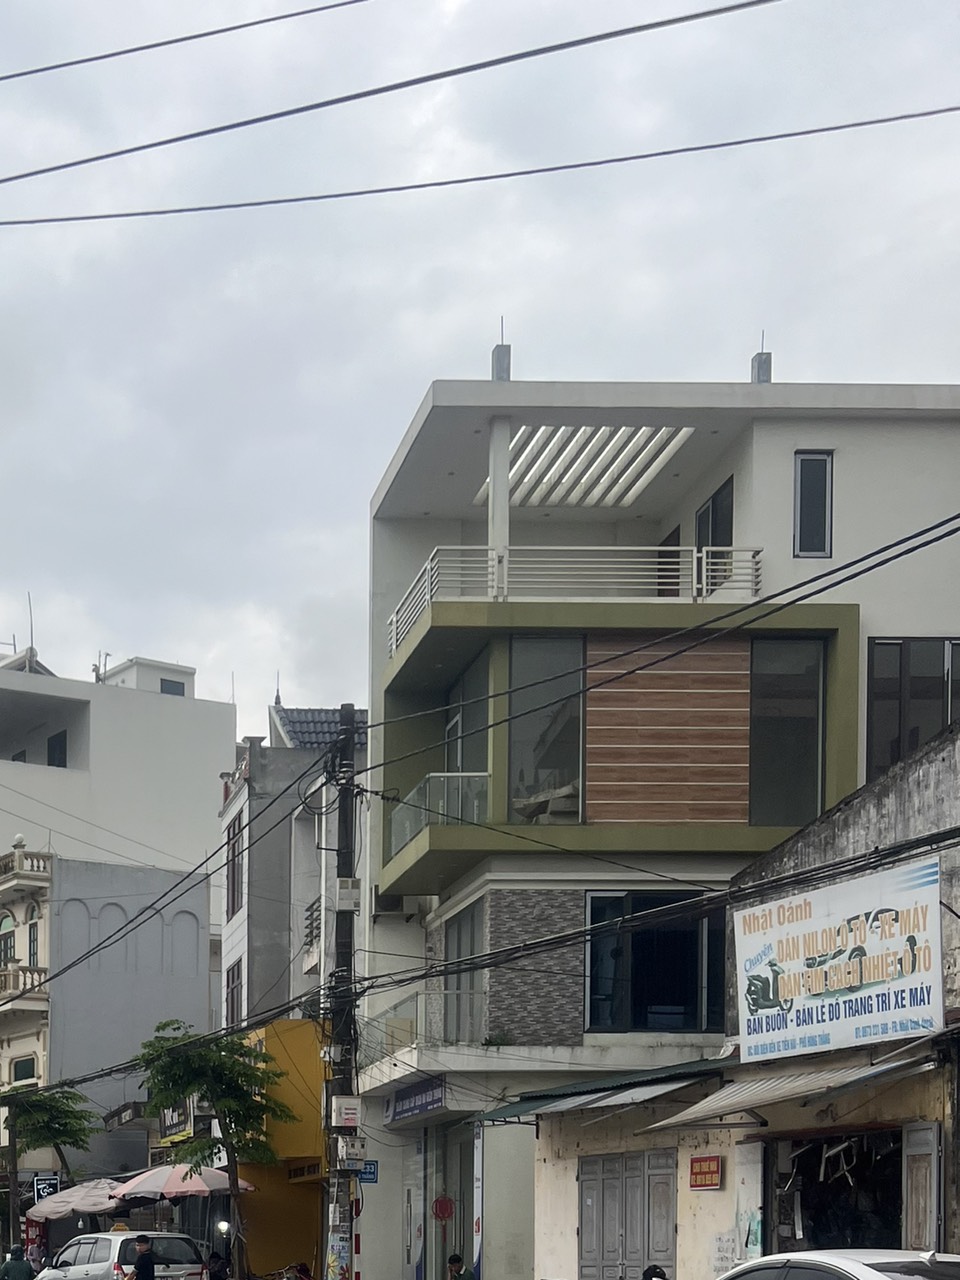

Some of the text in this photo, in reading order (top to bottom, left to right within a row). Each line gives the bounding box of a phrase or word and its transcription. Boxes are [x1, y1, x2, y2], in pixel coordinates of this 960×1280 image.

[742, 898, 812, 936] Nhật Oánh
[802, 925, 837, 958] NILON
[879, 911, 896, 941] XE
[899, 902, 929, 936] MÁY
[861, 946, 899, 984] NHIỆT
[914, 939, 932, 973] TÔ
[842, 995, 873, 1019] TRANG
[875, 988, 891, 1013] TRÍ
[893, 991, 907, 1010] XE
[909, 982, 932, 1008] MÁY
